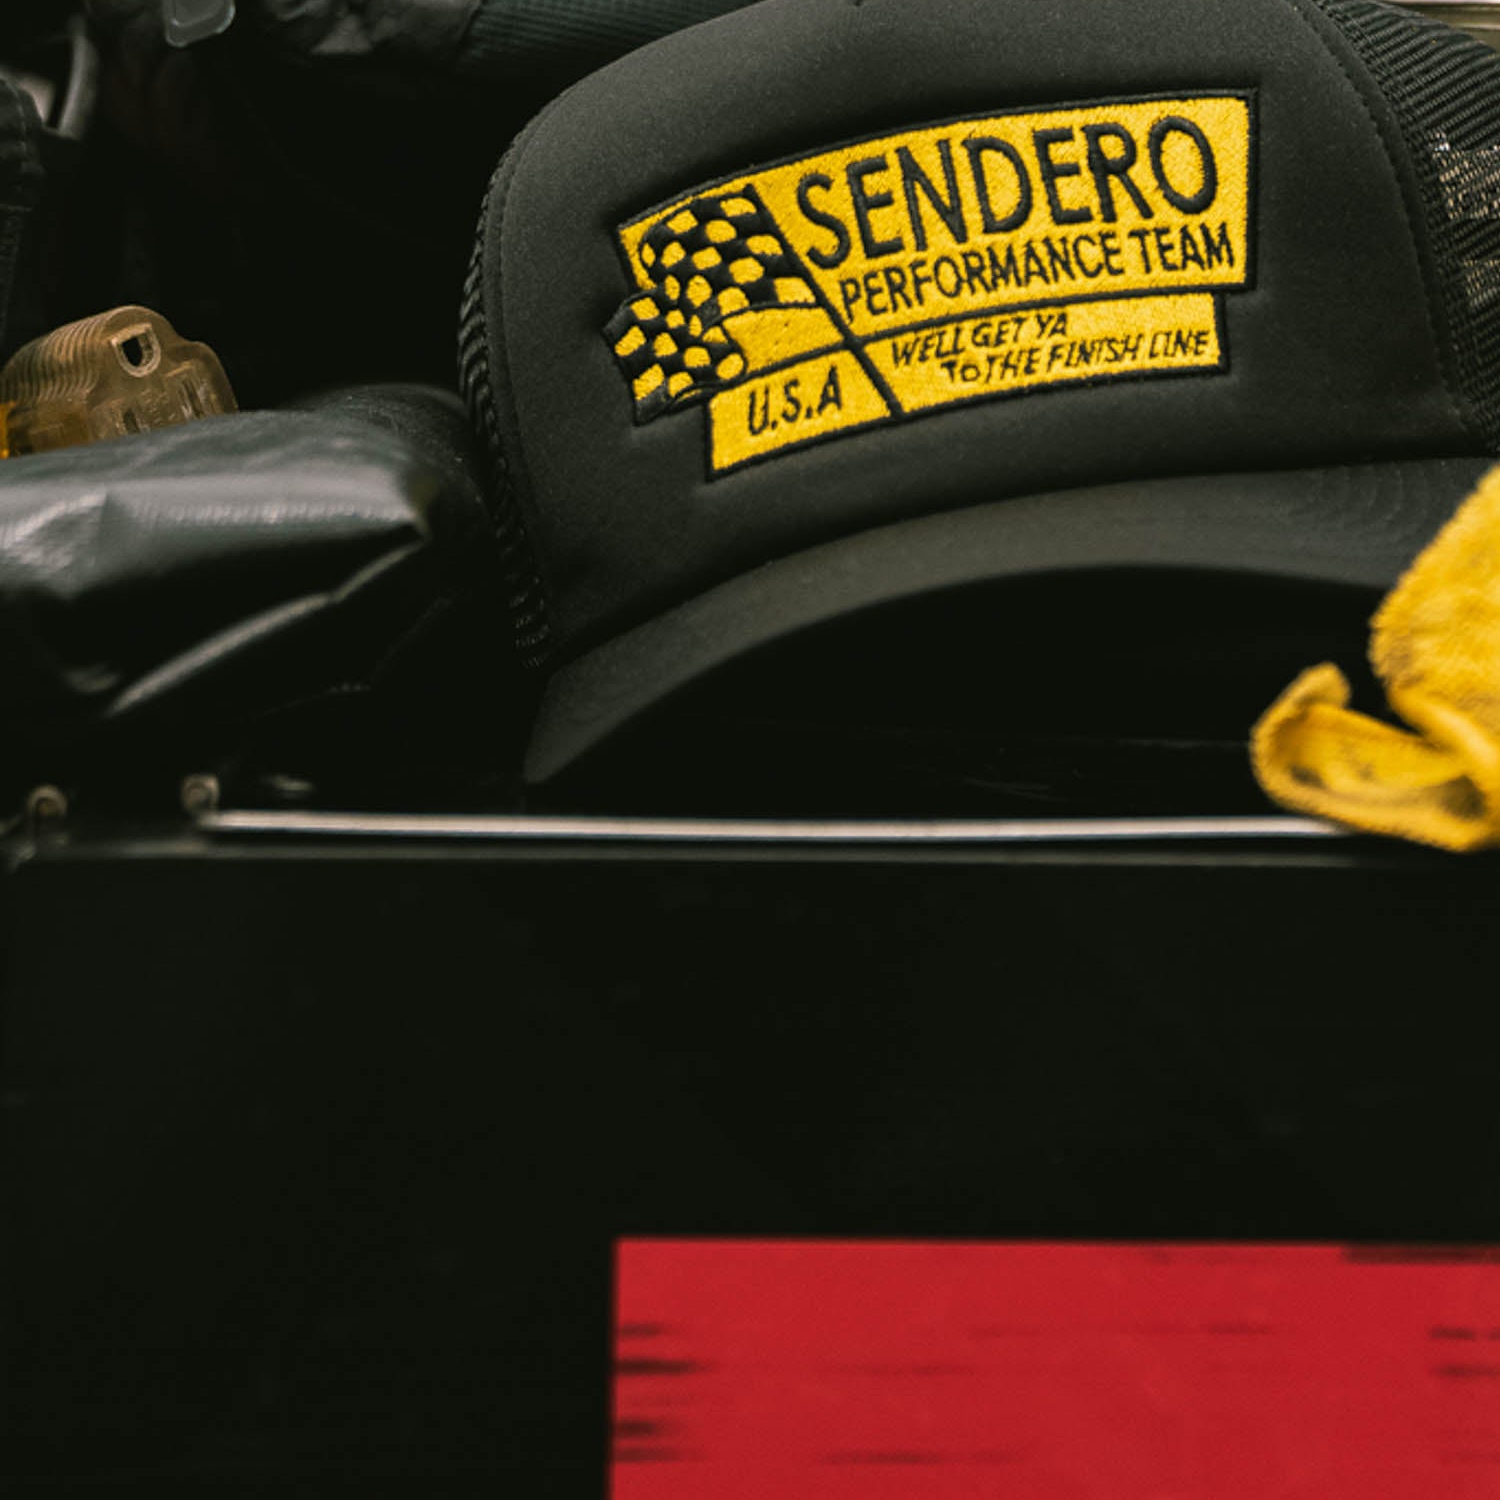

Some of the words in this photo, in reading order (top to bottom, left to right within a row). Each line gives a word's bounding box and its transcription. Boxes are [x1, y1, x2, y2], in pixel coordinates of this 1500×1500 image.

[799, 115, 1219, 270] SENDERO
[838, 232, 1124, 323] PERFORMANCE
[1128, 223, 1235, 274] TEAM
[971, 317, 1027, 348] GET
[1036, 312, 1068, 339] YA
[986, 346, 1041, 384] THE
[1046, 333, 1144, 373] FINISH
[1149, 329, 1209, 359] LINE
